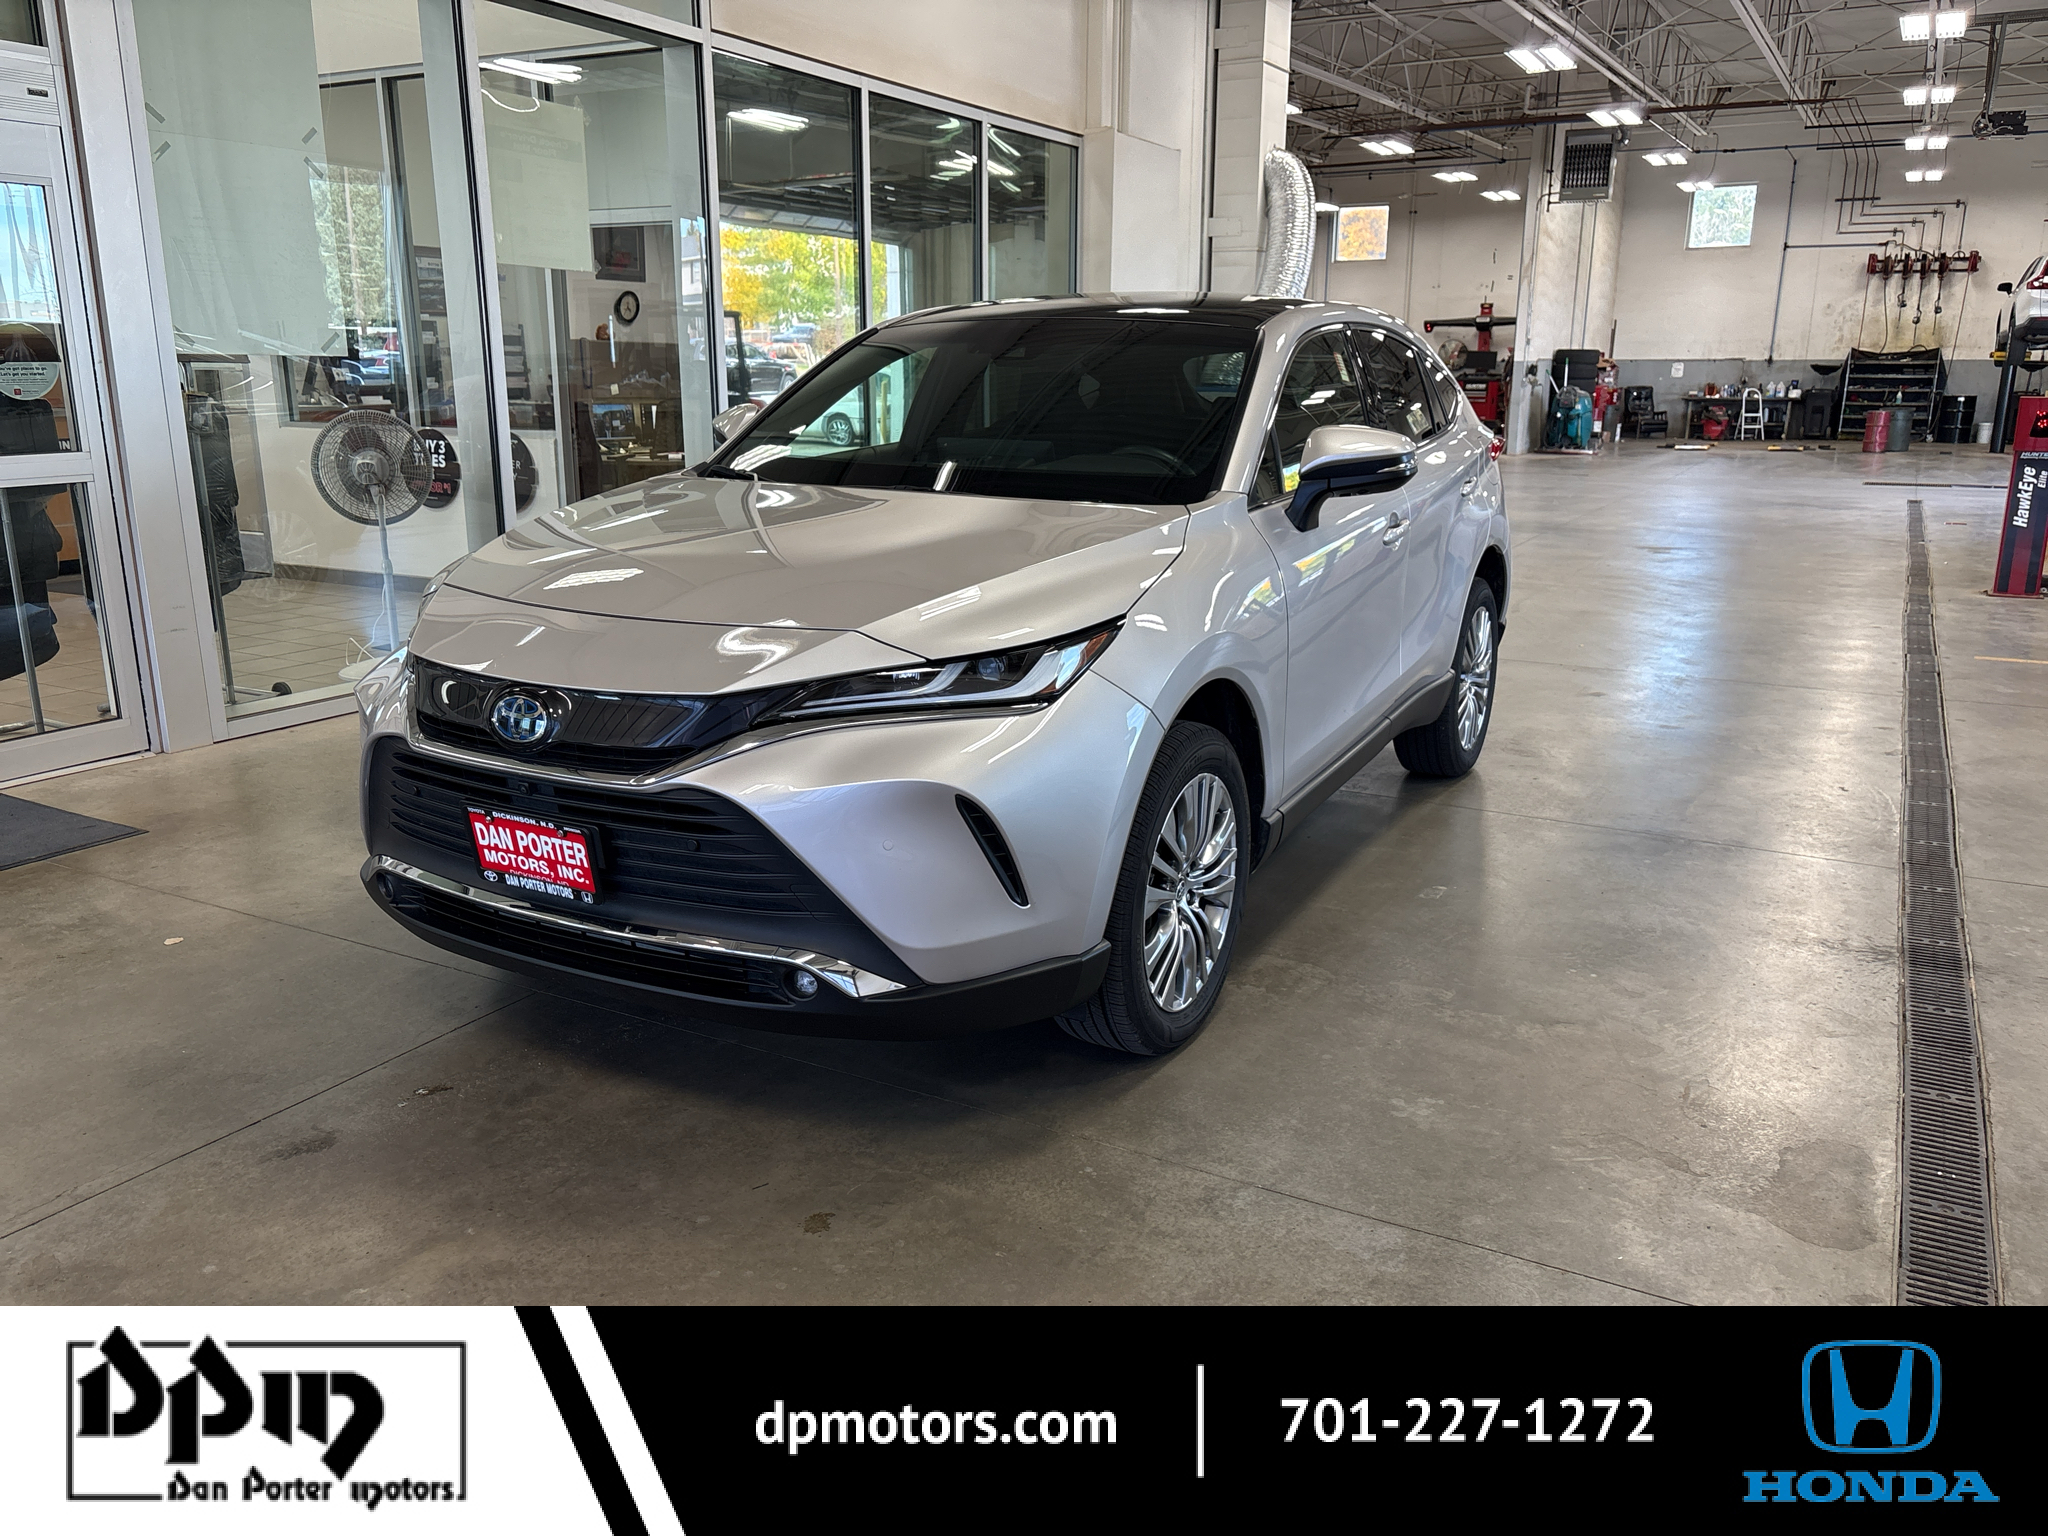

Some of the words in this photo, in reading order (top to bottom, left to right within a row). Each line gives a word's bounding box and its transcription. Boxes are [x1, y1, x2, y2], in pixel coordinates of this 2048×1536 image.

[413, 452, 446, 468] TIES
[438, 440, 446, 454] 3
[2037, 470, 2048, 489] Elite
[2012, 466, 2038, 528] HawkEye
[474, 821, 514, 852] DAN
[515, 829, 589, 868] PORTER
[483, 849, 555, 878] MOTORS,
[557, 864, 590, 884] INC.
[504, 873, 520, 888] DAN
[520, 877, 547, 894] PORTER
[546, 882, 575, 900] MOTORS
